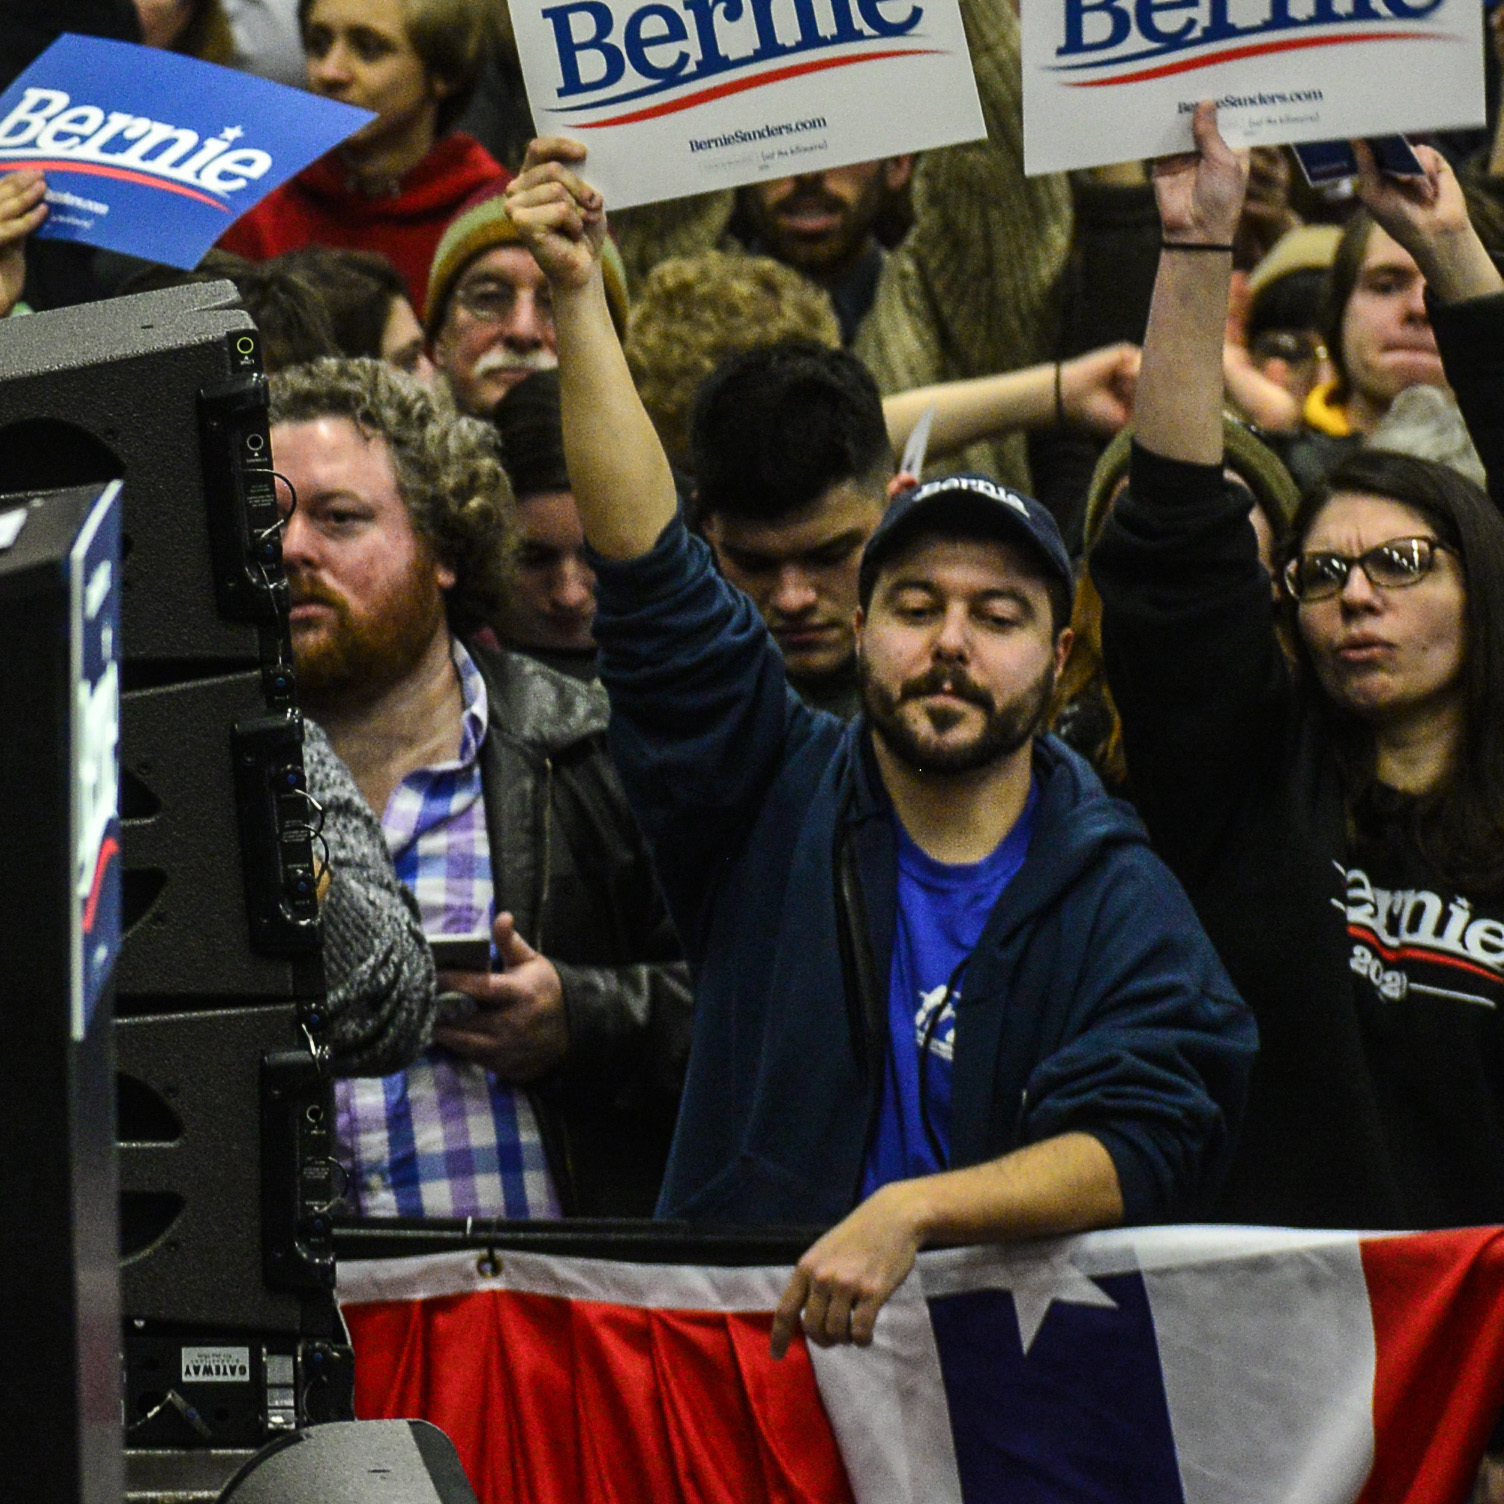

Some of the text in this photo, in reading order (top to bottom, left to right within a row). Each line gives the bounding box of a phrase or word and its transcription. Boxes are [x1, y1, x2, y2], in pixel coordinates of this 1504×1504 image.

[689, 117, 828, 153] BernieSanders.com
[1331, 860, 1504, 971] ernie
[183, 1363, 248, 1379] GATEWAY
